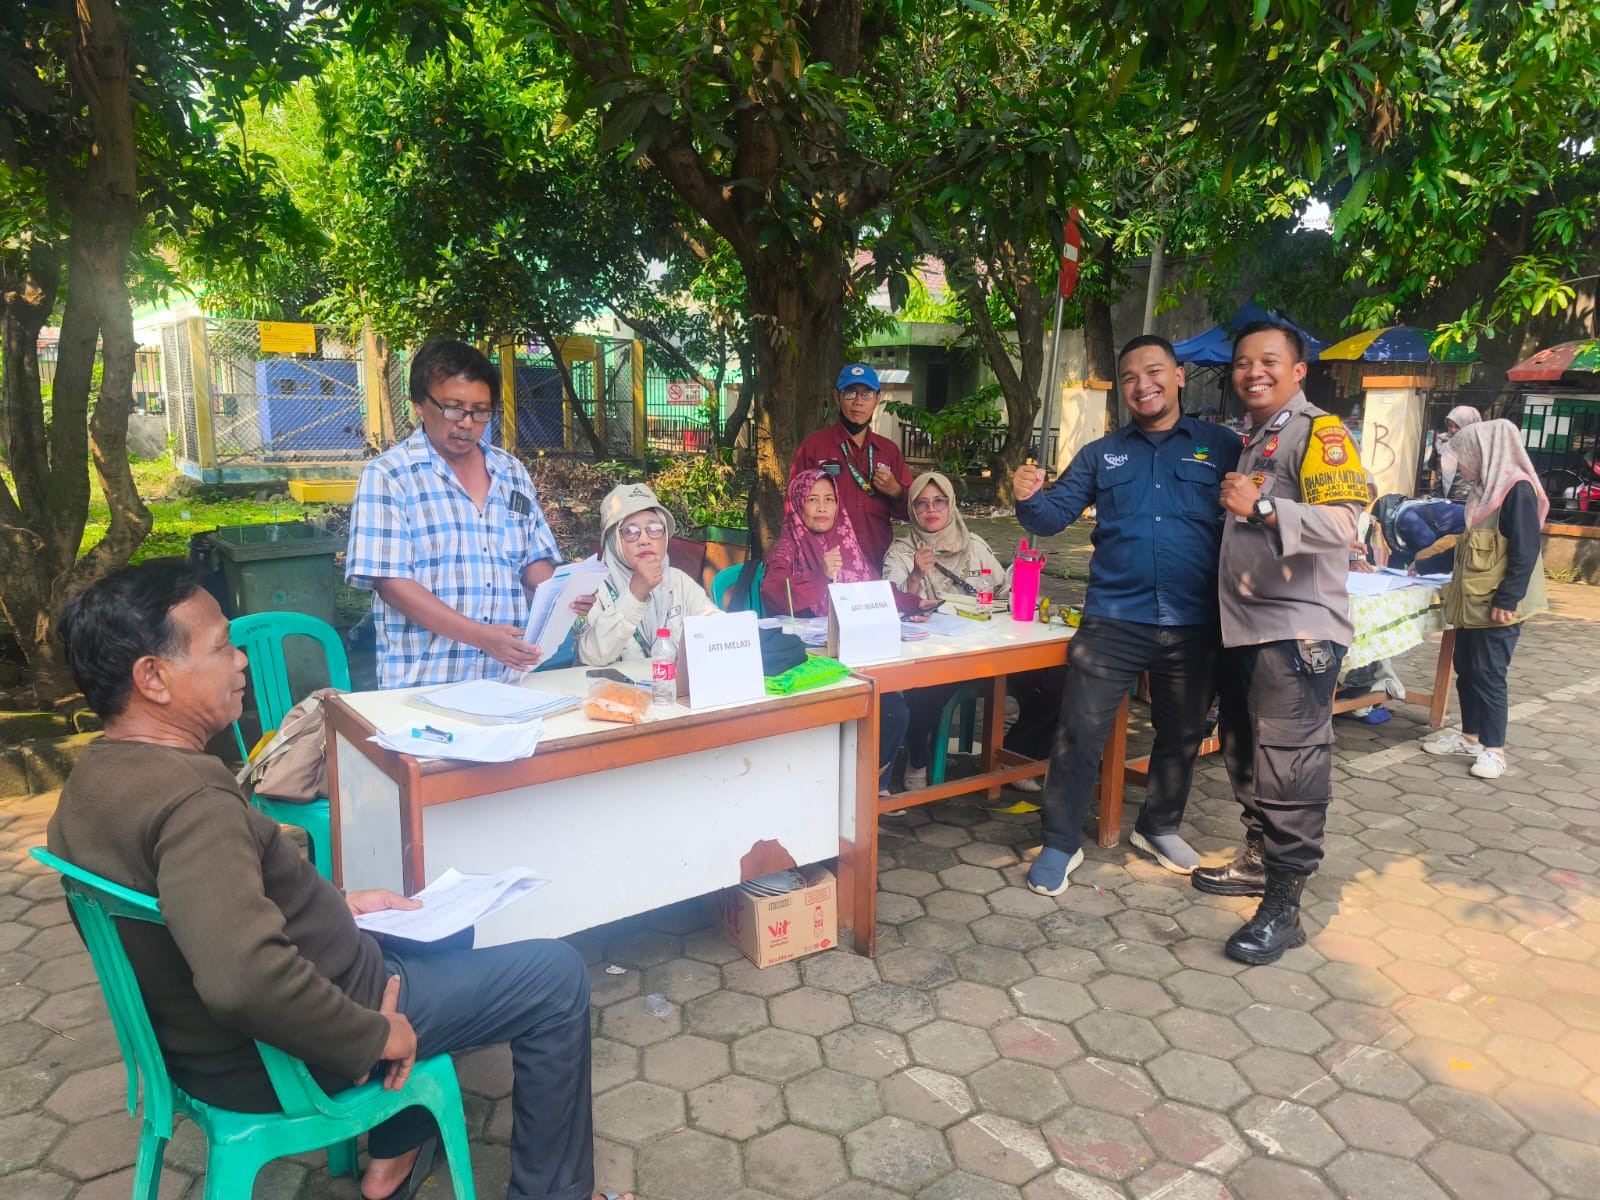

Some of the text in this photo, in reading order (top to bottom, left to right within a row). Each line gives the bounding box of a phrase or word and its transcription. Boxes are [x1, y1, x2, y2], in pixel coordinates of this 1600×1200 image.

[1371, 421, 1396, 475] B
[709, 640, 751, 652] JATI MELATI
[768, 920, 790, 937] Vit
